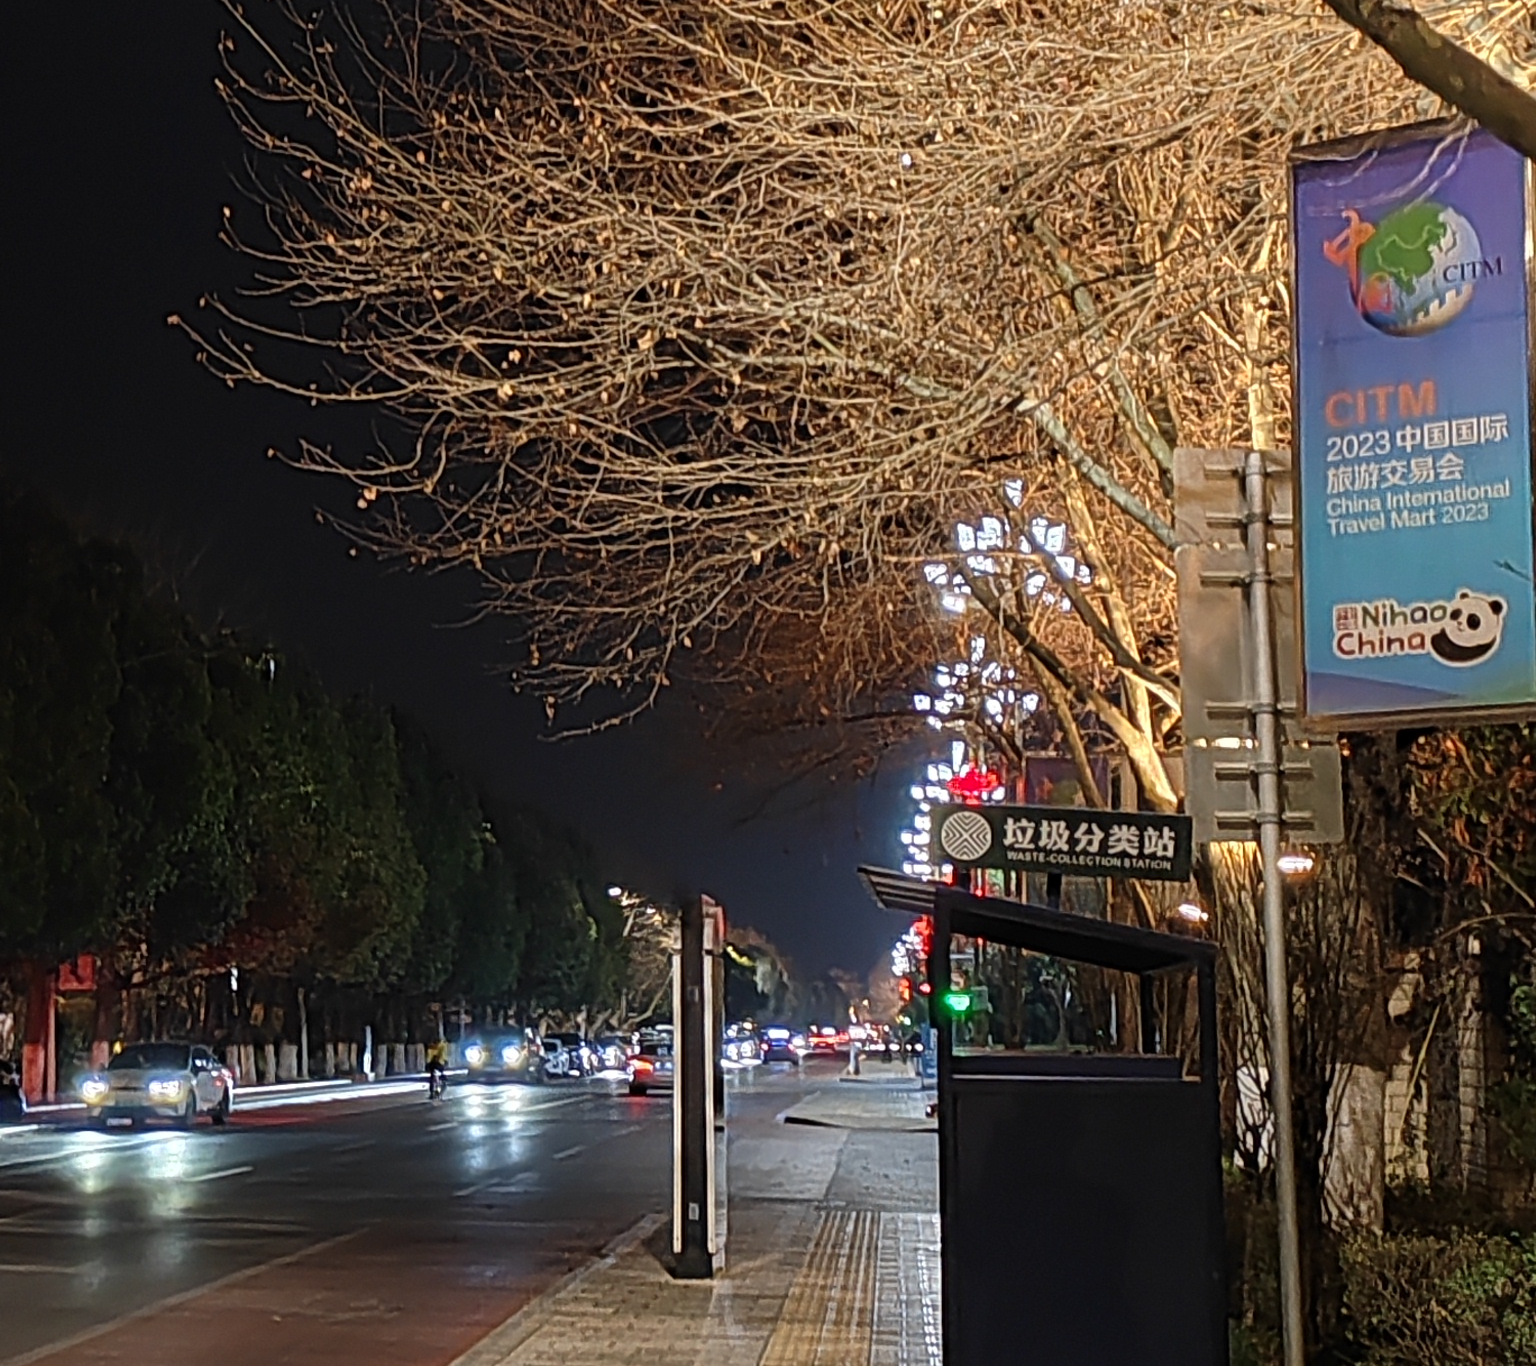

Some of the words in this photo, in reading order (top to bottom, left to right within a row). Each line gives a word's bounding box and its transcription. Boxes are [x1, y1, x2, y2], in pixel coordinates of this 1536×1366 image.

[1443, 256, 1503, 283] CITM
[1325, 380, 1437, 428] CITM
[1326, 430, 1392, 462] 2023
[1396, 413, 1509, 454] 中国国际
[1327, 452, 1464, 494] 旅游交易会
[1327, 494, 1382, 516] China
[1387, 477, 1510, 510] International
[1327, 513, 1385, 537] Travel
[1391, 507, 1436, 529] Mart
[1442, 502, 1489, 524] 2023
[1361, 601, 1448, 629] Nihao
[1336, 629, 1426, 656] China
[1003, 817, 1176, 859] 垃圾分类站
[1123, 856, 1172, 871] STATION
